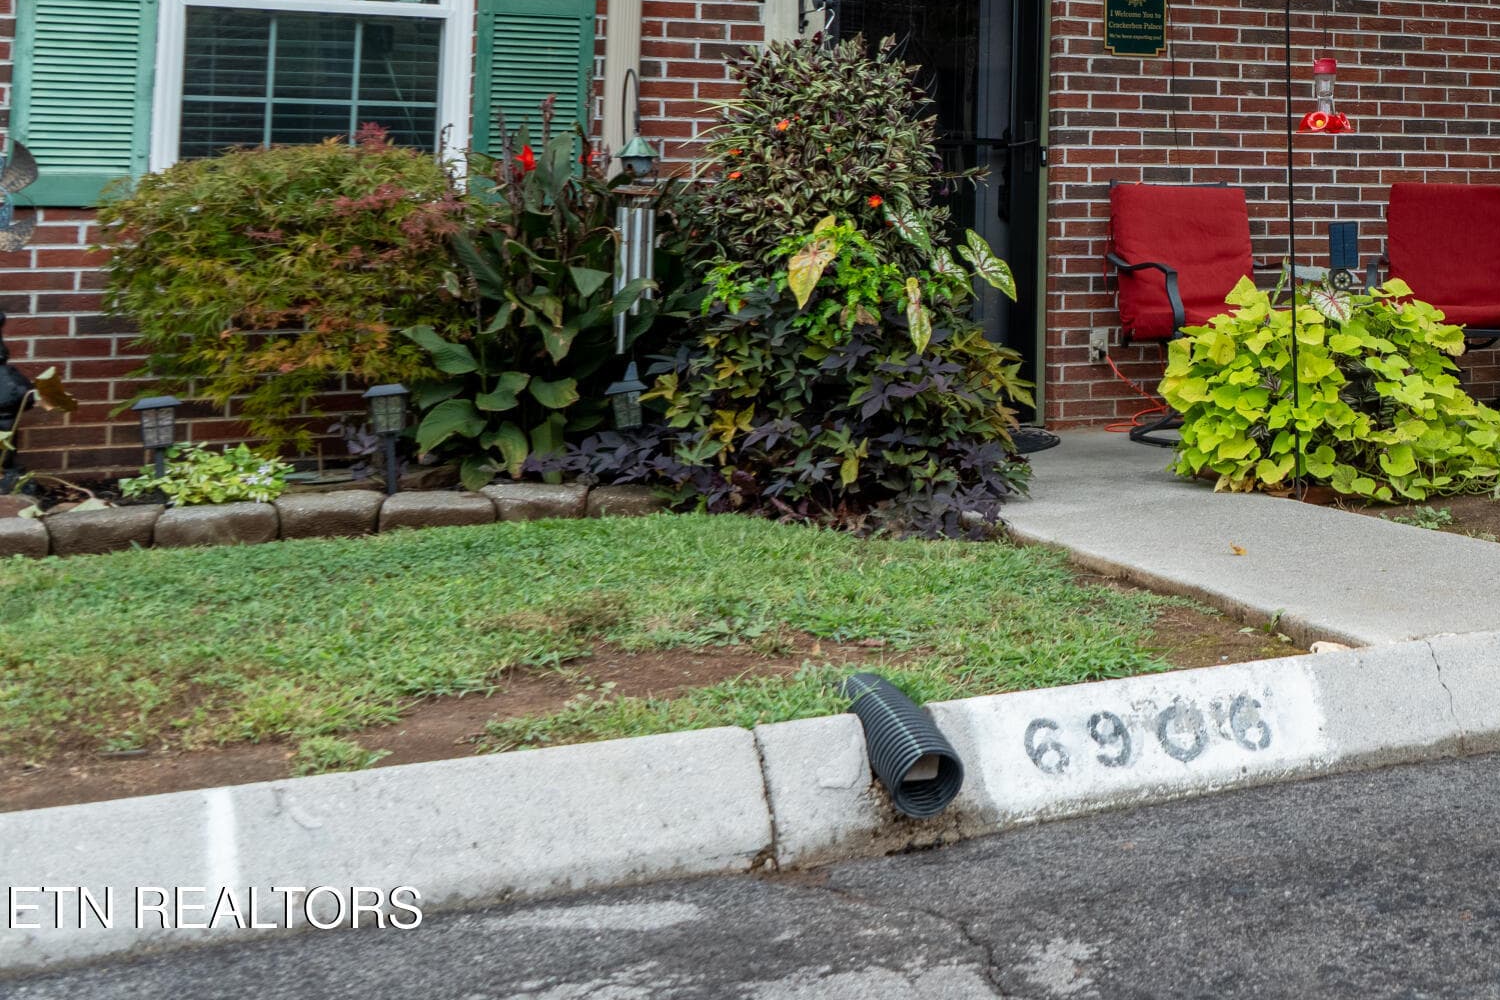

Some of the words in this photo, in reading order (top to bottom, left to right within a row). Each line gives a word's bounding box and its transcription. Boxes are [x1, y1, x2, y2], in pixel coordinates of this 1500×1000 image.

[1114, 10, 1142, 18] Welcome
[1142, 11, 1154, 19] You
[1024, 693, 1272, 774] 6906
